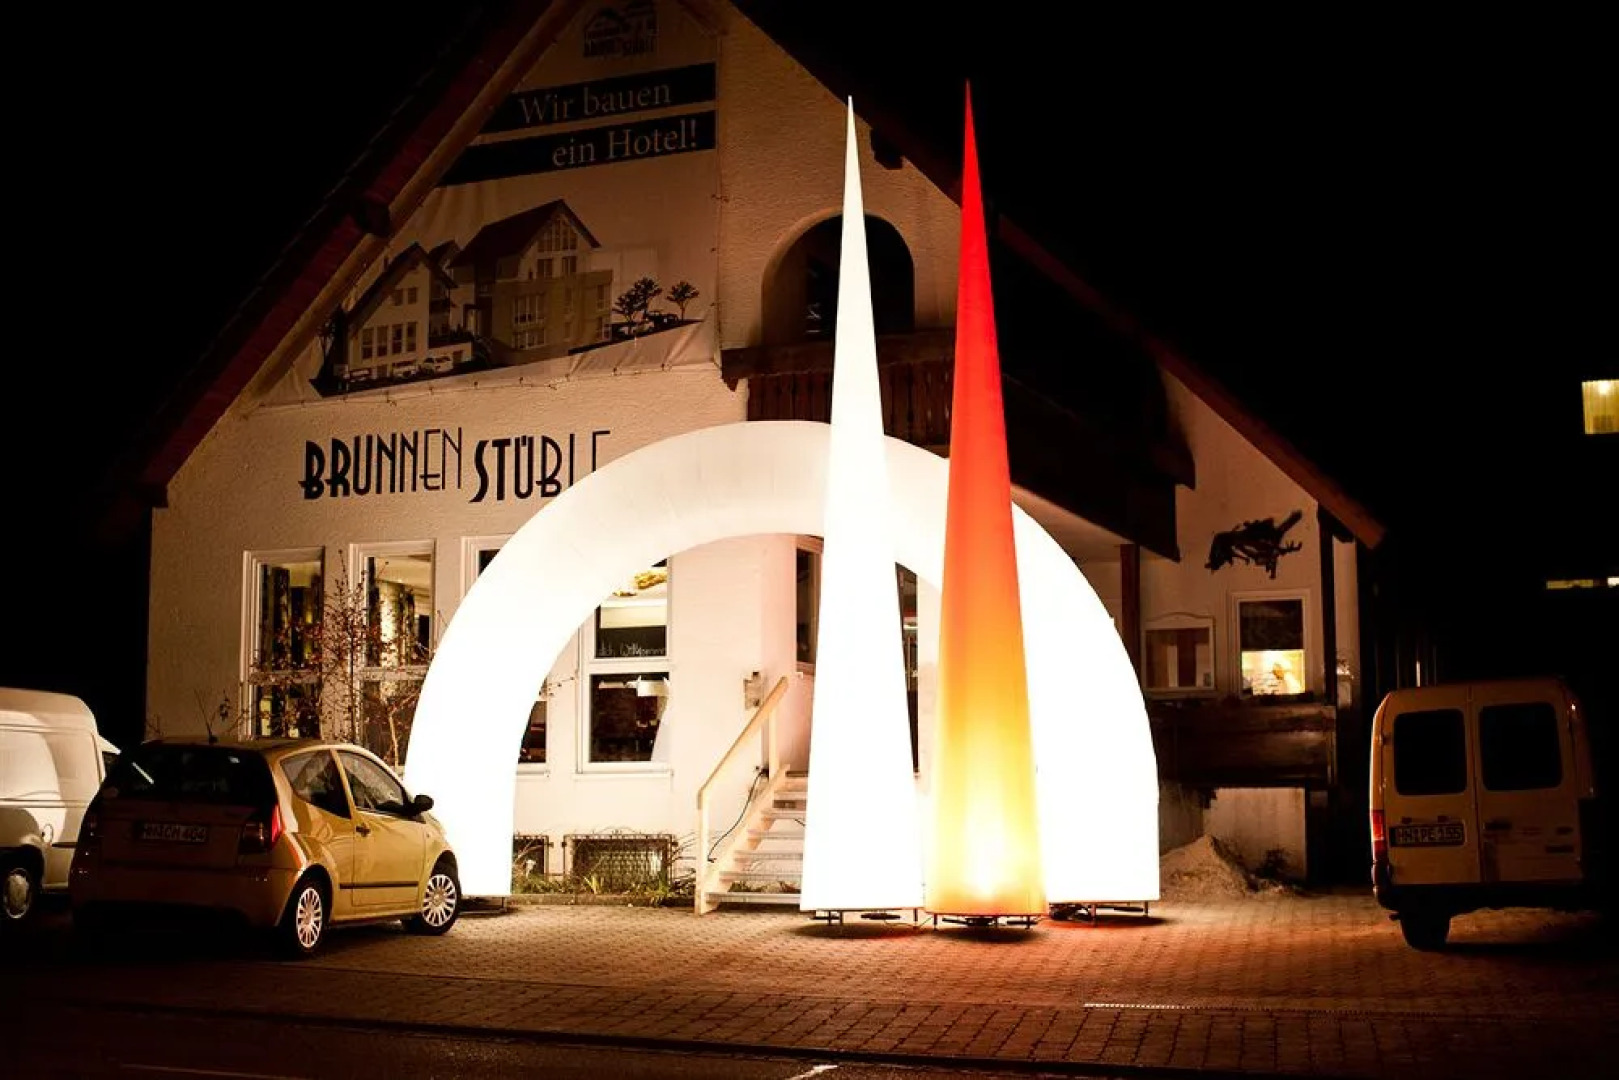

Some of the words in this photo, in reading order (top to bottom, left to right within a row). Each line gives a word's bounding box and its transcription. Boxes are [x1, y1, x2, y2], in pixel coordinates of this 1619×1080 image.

[519, 93, 577, 124] Wir
[582, 82, 673, 117] bauen
[552, 136, 596, 167] ein
[607, 118, 698, 159] Hotel!
[298, 427, 462, 499] BRUNNEN
